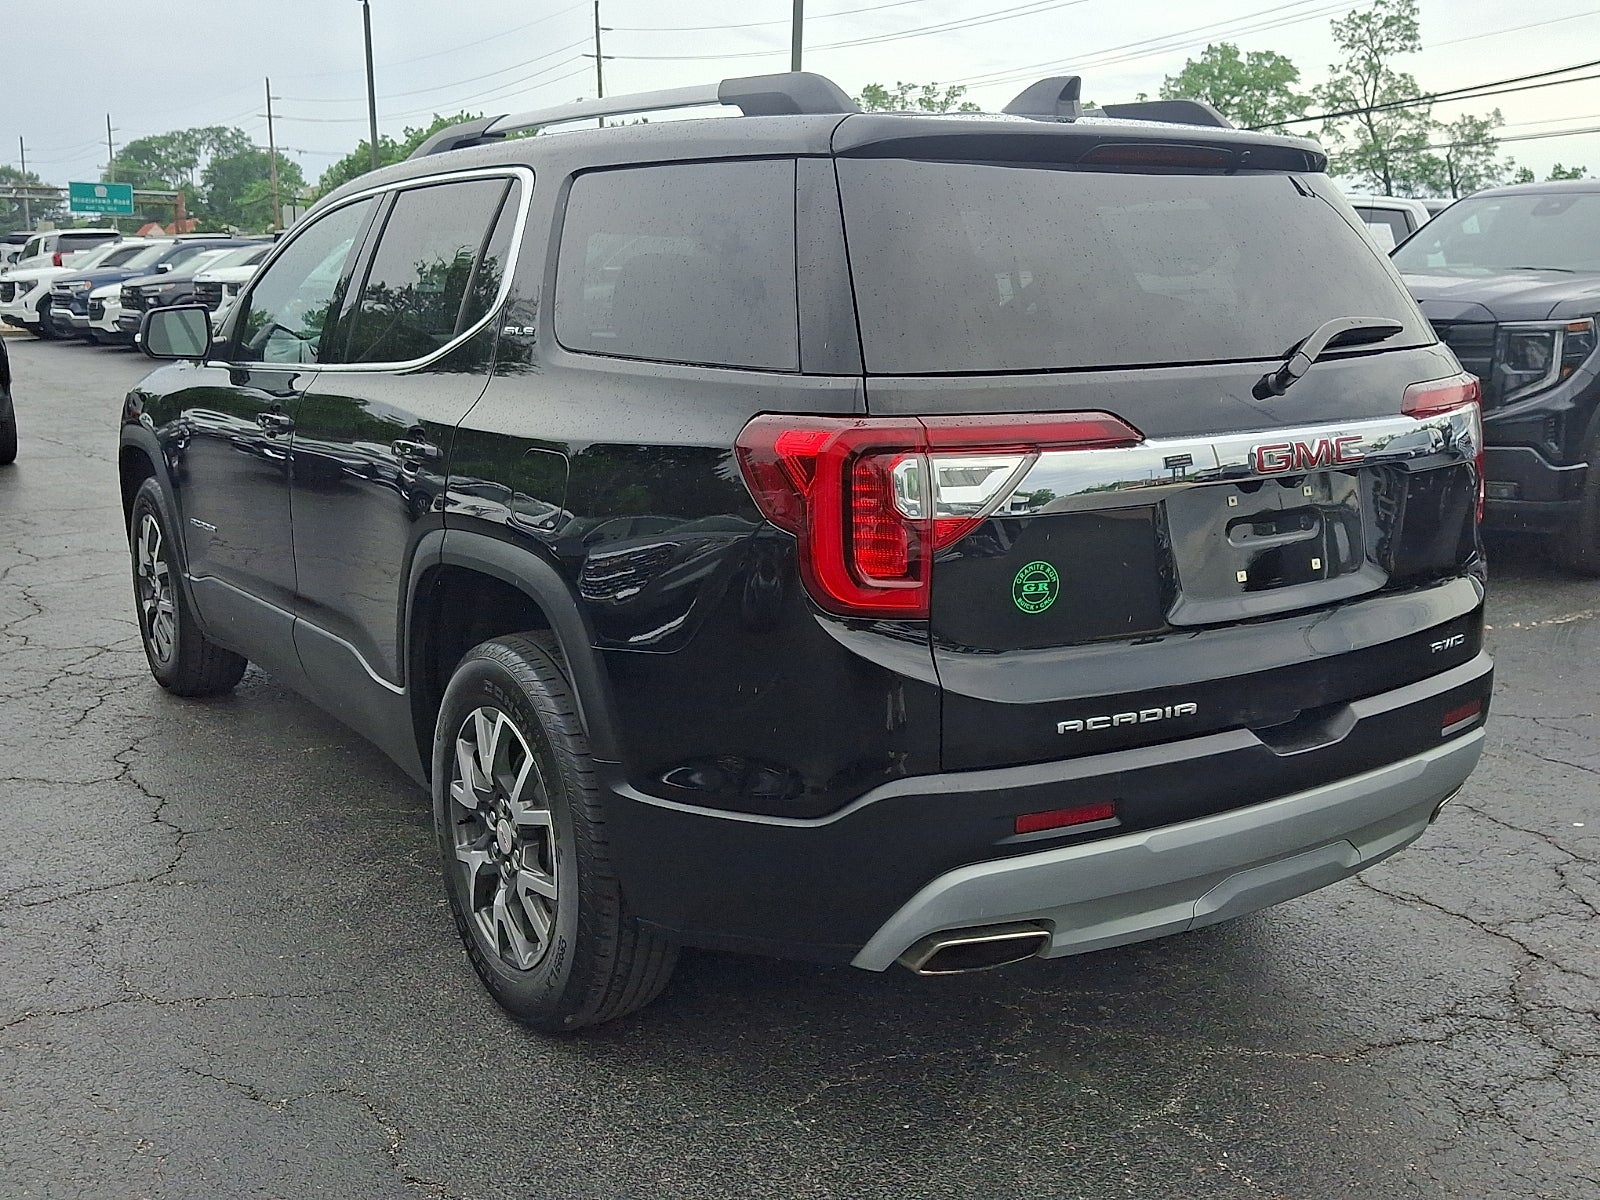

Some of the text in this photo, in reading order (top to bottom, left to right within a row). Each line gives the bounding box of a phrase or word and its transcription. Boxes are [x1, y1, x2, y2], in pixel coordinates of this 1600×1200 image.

[503, 326, 535, 335] SLE
[1254, 435, 1365, 473] GMC
[1016, 564, 1057, 584] GRANITE RUN
[1023, 582, 1049, 592] GR
[1017, 596, 1053, 610] BUICK GMC
[1057, 702, 1198, 734] ACADIA
